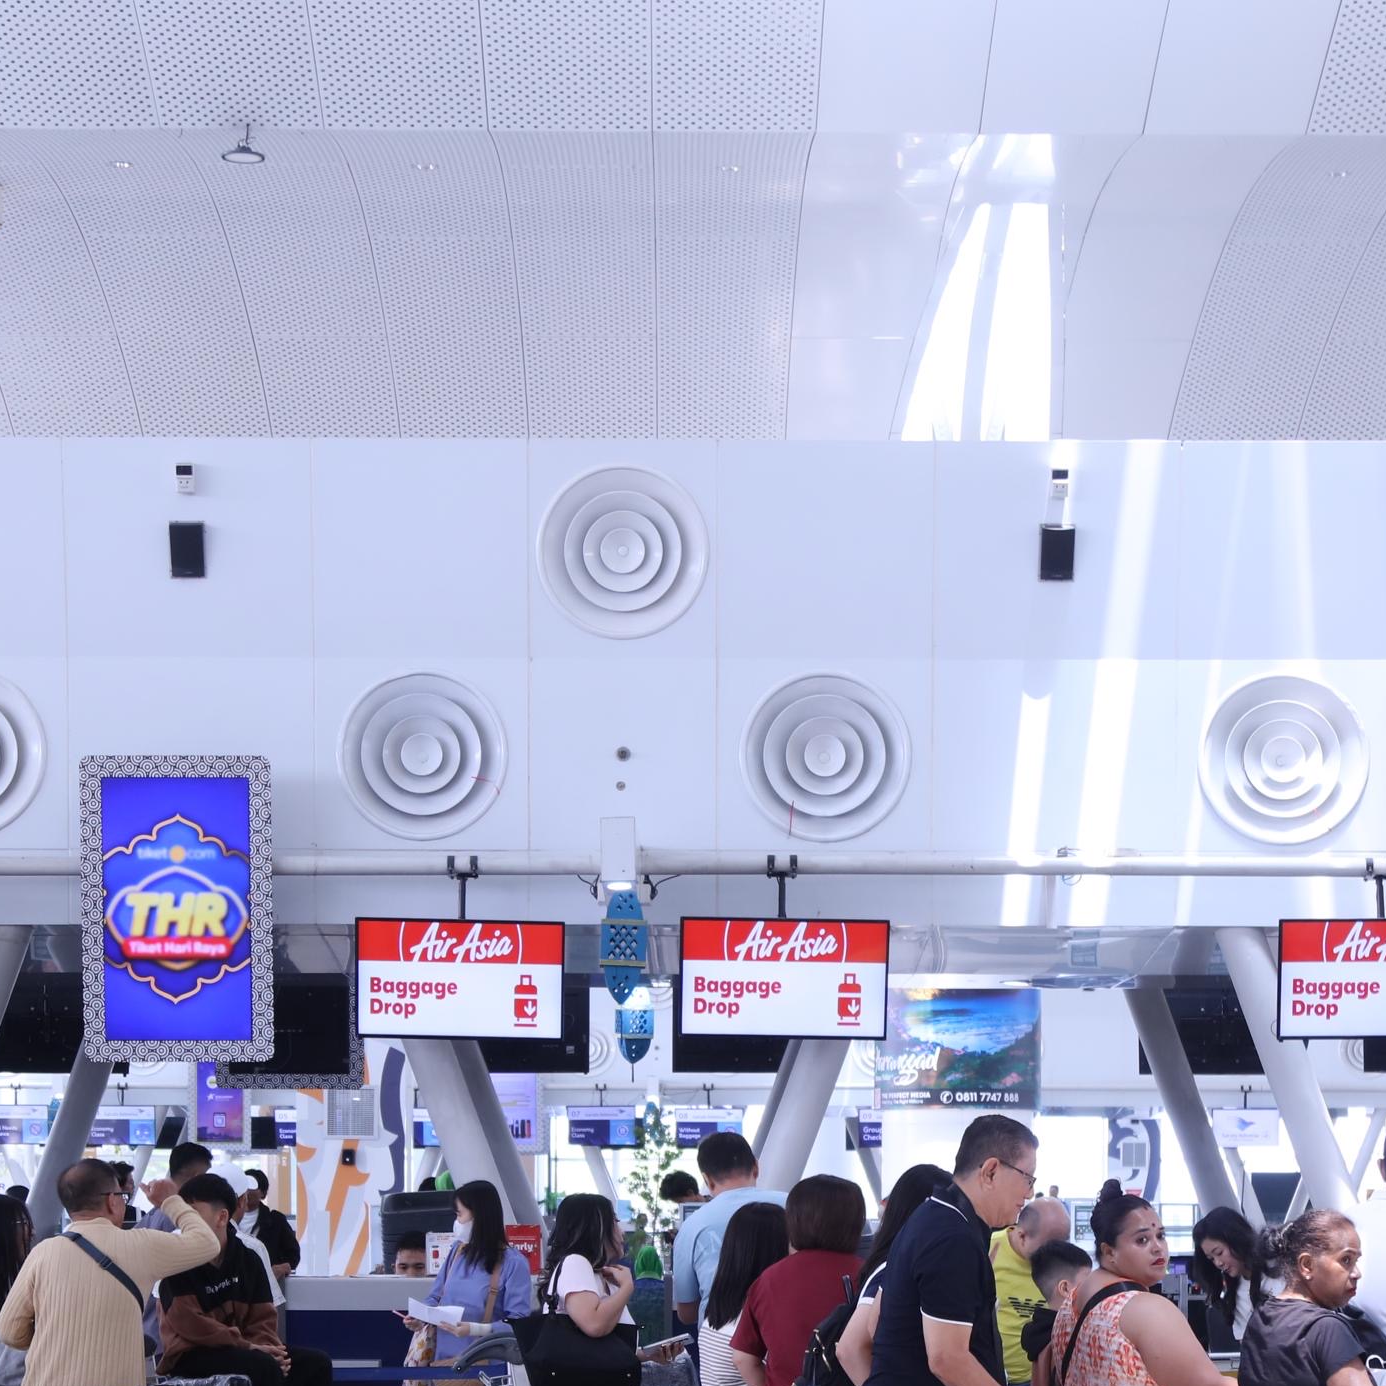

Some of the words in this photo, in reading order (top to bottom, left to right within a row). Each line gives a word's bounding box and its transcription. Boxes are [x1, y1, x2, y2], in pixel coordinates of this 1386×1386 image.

[125, 892, 228, 937] THR
[129, 941, 163, 953] Tiket
[164, 941, 192, 953] Hari
[194, 941, 227, 956] Raya
[370, 977, 458, 999] Baggage
[694, 976, 782, 998] Baggage
[1292, 978, 1380, 999] Baggage
[370, 999, 416, 1019] Drop
[694, 998, 740, 1018] Drop
[1292, 1000, 1339, 1019] Drop
[955, 1092, 977, 1102] 0811
[980, 1092, 1001, 1101] 7747
[1004, 1093, 1019, 1102] 888
